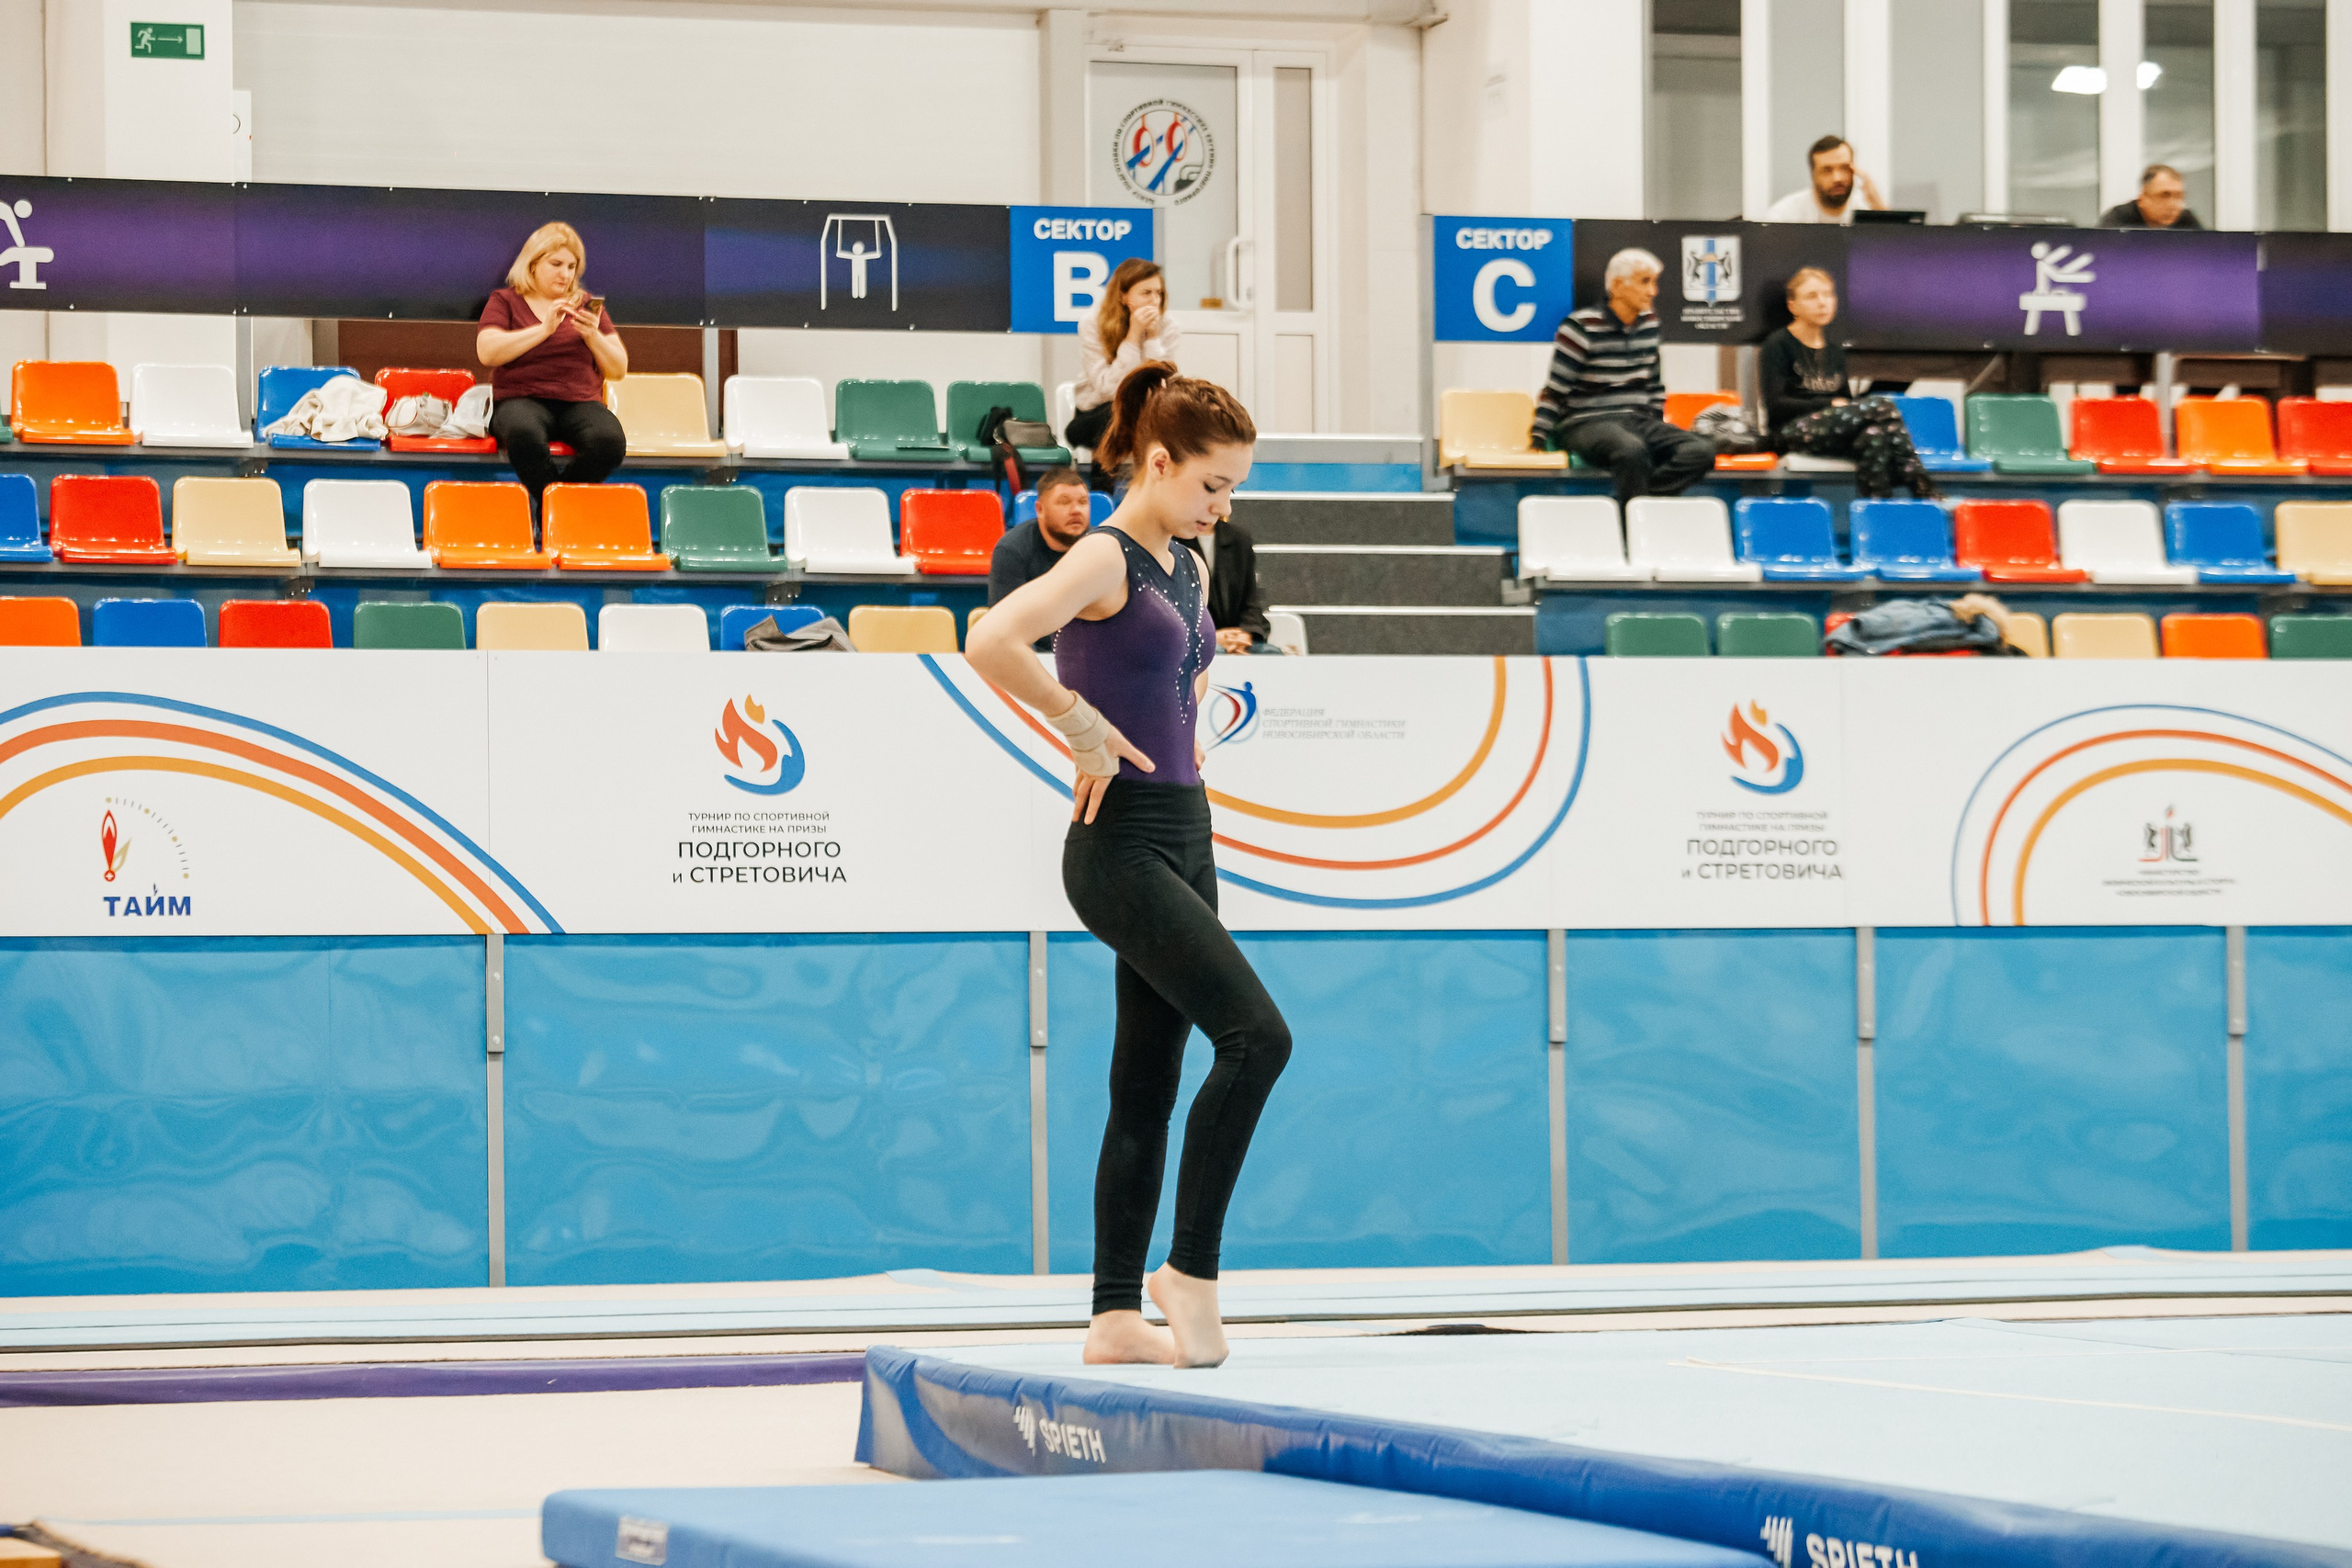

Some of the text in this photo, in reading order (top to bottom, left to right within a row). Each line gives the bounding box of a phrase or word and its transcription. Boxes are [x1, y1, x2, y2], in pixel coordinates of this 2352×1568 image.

[1034, 218, 1132, 241] СЕКТОР
[1455, 227, 1554, 250] СЕКТОР
[1261, 708, 1325, 717] ФЕДЕРАЦИЯ
[1261, 718, 1333, 728] СПОРТИВНОЙ
[688, 811, 830, 821] ТУРНИР ПО СПОРТИВНОЙ
[692, 825, 827, 834] ГИМНАСТИКЕ НА ПРИЗЫ
[678, 841, 841, 862] ПОДГОРНОГО
[1687, 840, 1838, 857] ПОДГОРНОГО
[673, 866, 847, 884] и СТРЕТОВИЧА
[1697, 863, 1843, 880] СТРЕТОВИЧА
[103, 884, 191, 917] ТАЙМ
[1039, 1417, 1107, 1464] SPIETH
